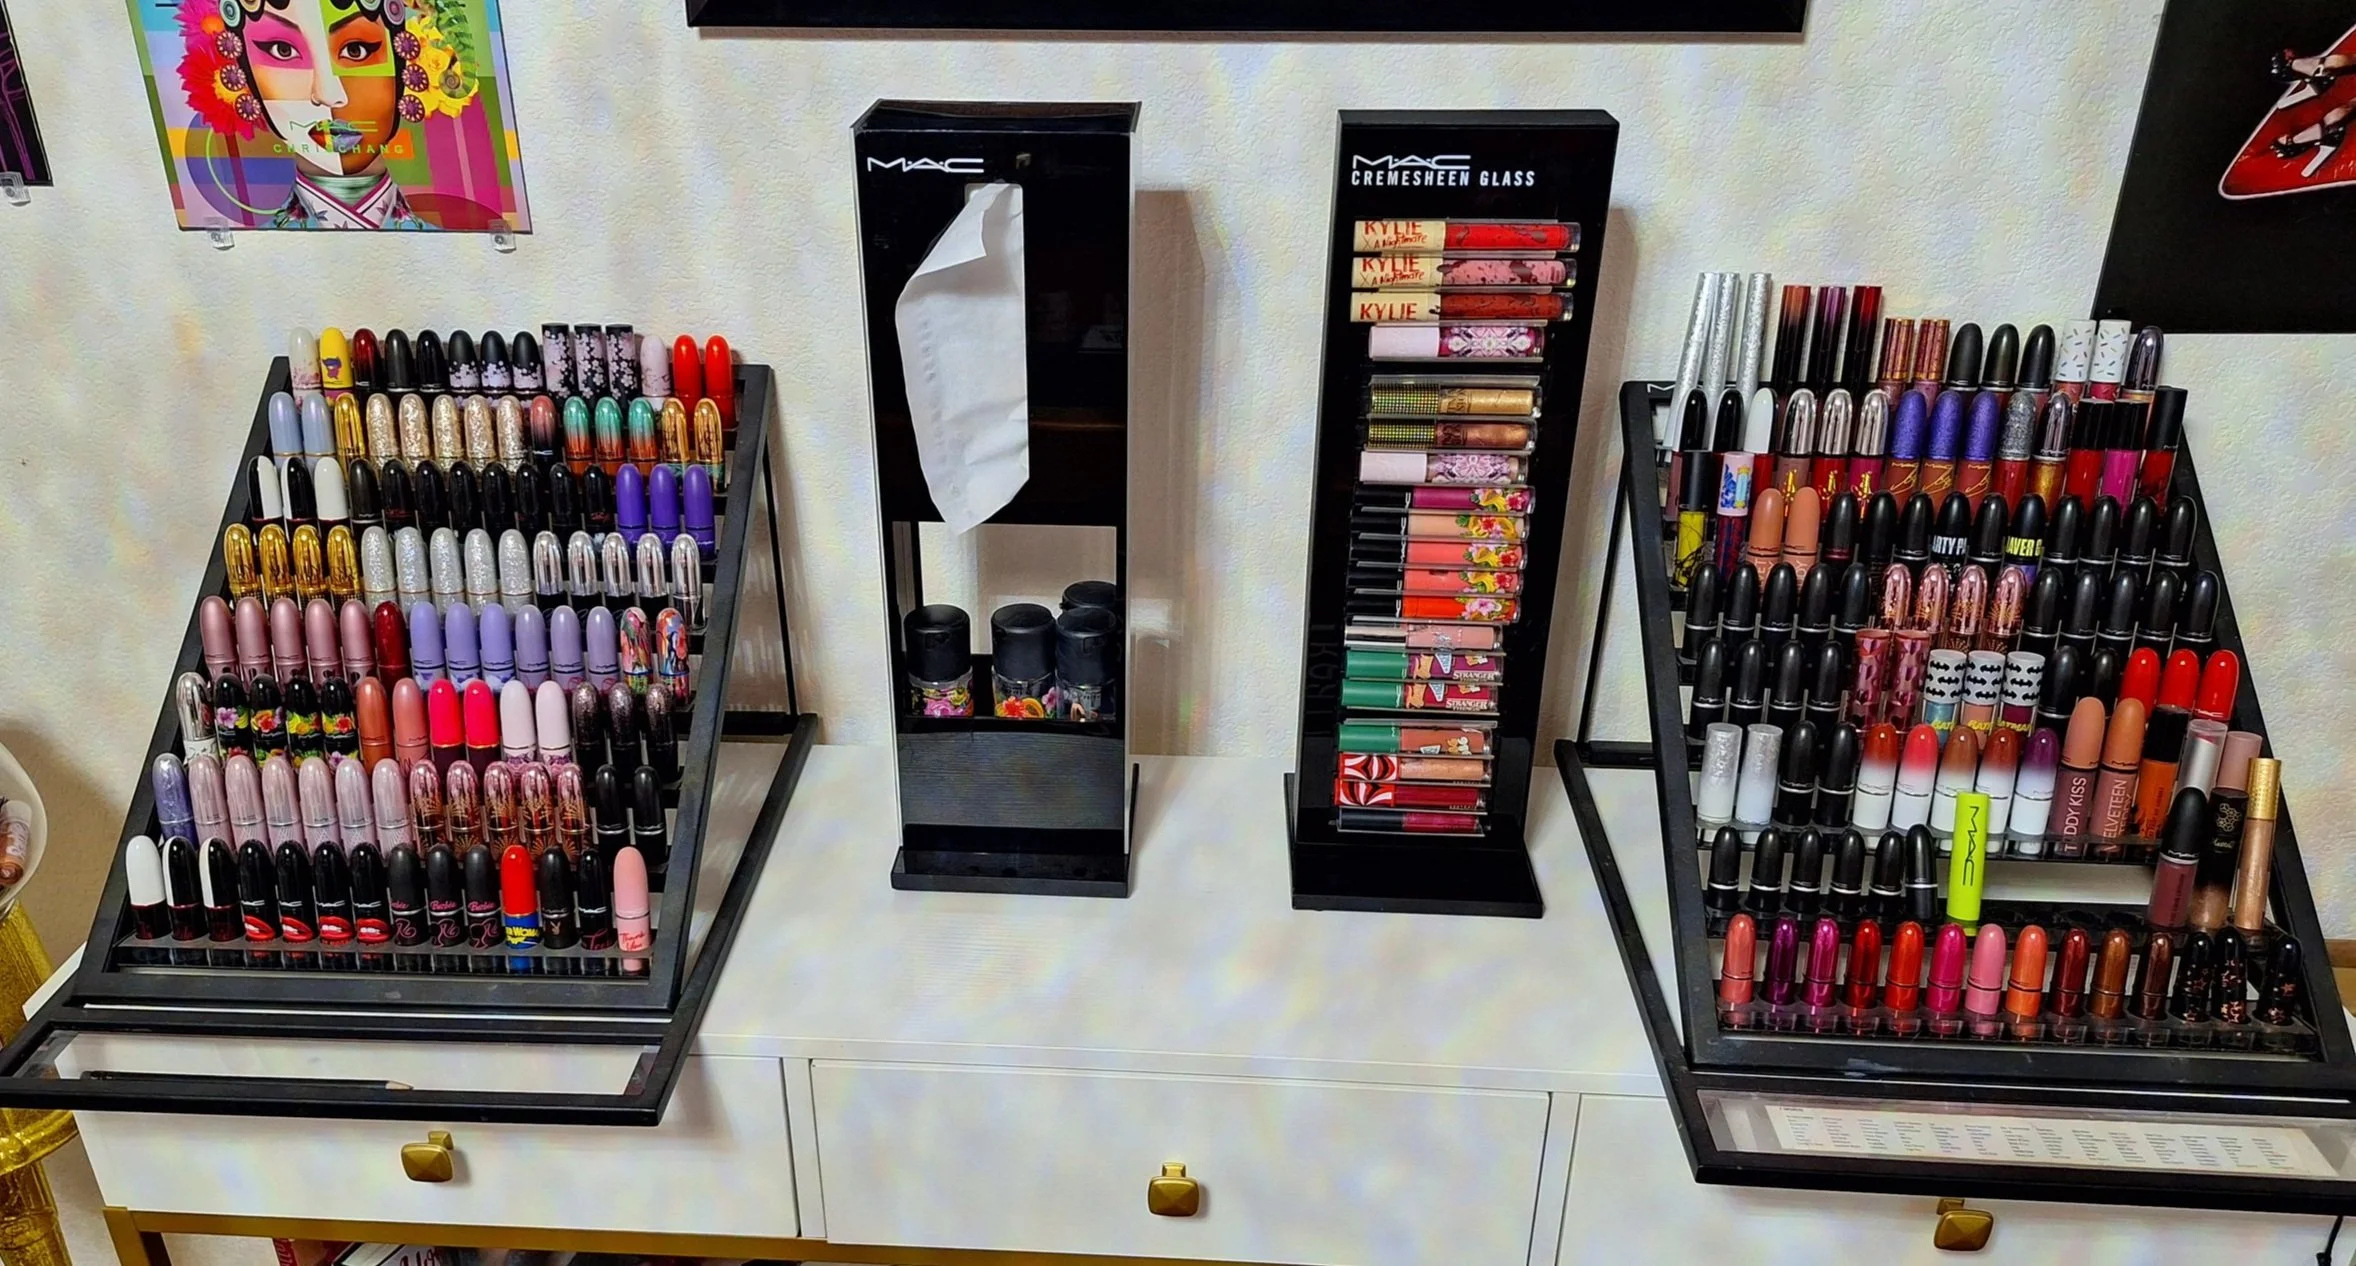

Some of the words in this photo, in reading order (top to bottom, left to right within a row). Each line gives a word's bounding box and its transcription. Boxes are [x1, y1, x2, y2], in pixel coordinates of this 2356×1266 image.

[1351, 170, 1470, 186] CREMESHEEN
[1480, 171, 1536, 187] GLASS
[1363, 220, 1423, 236] KYLIE
[1361, 255, 1420, 273] KYLIE
[1360, 303, 1418, 320] KYLIE
[1453, 670, 1495, 680] STRANGER
[1446, 698, 1489, 710] STRANGER
[2068, 777, 2088, 806] KISS
